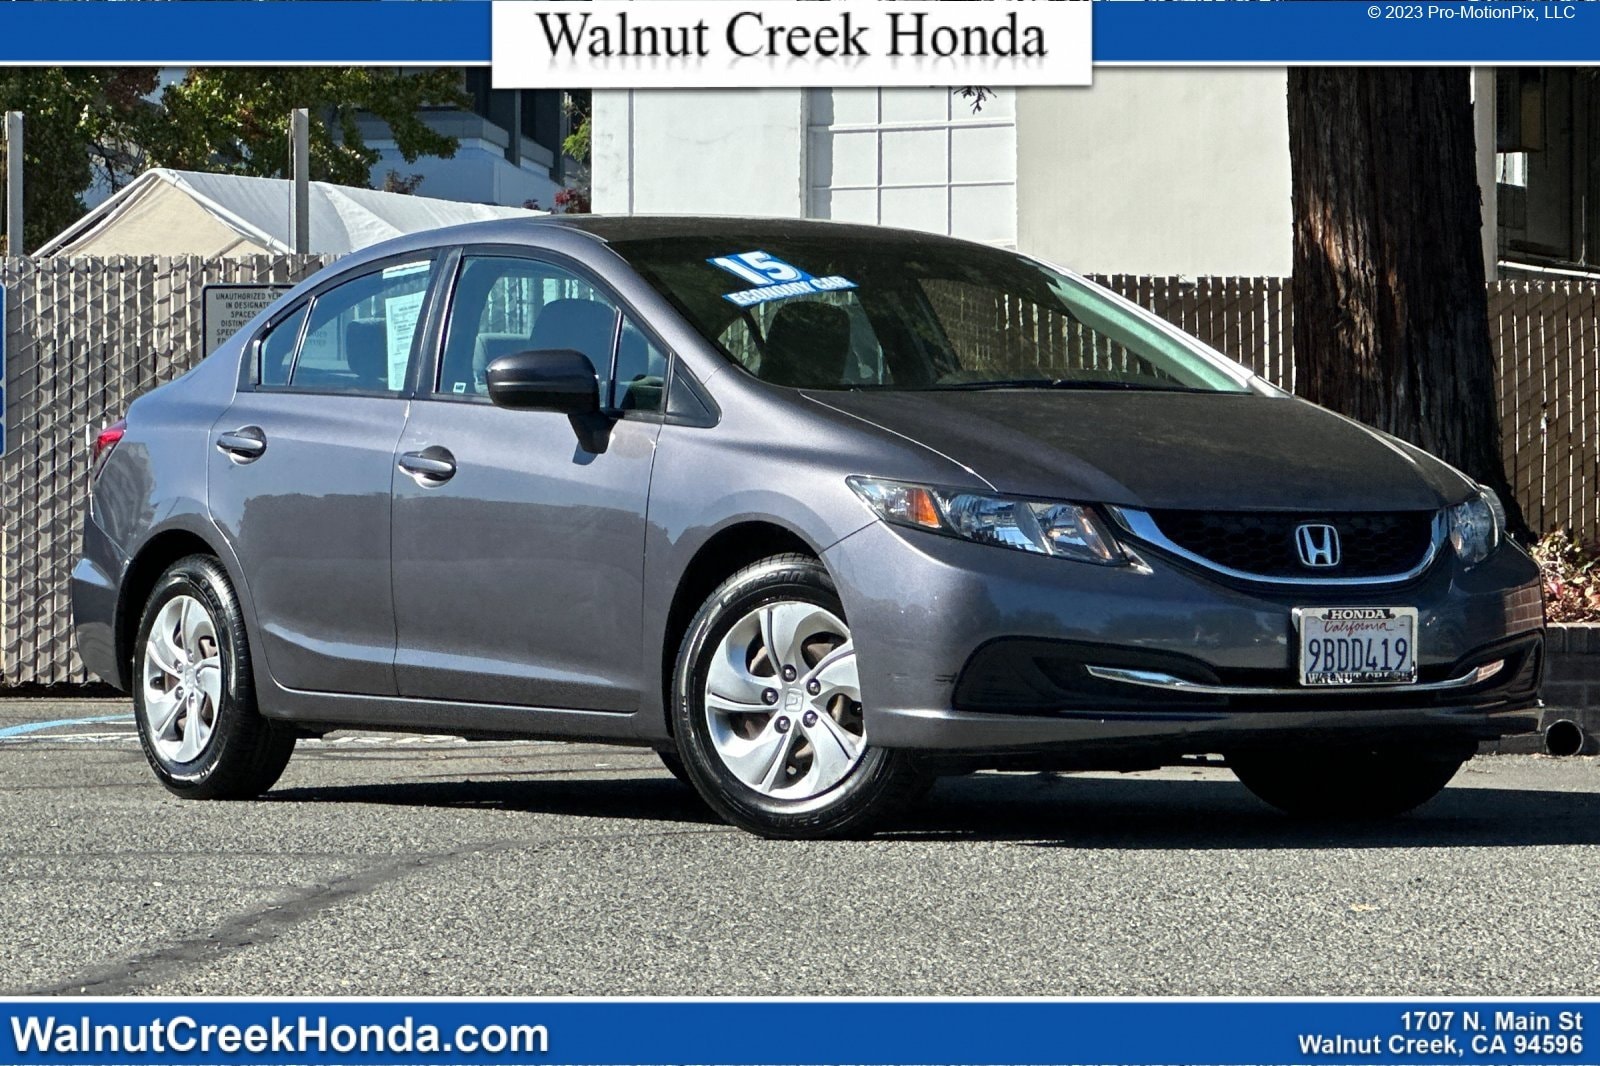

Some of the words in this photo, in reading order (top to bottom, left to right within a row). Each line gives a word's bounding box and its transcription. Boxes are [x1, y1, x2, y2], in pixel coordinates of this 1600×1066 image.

[713, 250, 802, 286] 15
[216, 292, 266, 300] UNAUTHORIZED
[727, 280, 817, 306] ECONOMY
[225, 301, 233, 309] IN
[234, 301, 270, 309] DESIGNATE
[1331, 609, 1387, 619] HONDA
[1324, 621, 1394, 637] California
[1308, 638, 1408, 671] 9BDD419
[1308, 672, 1362, 684] WALNUT
